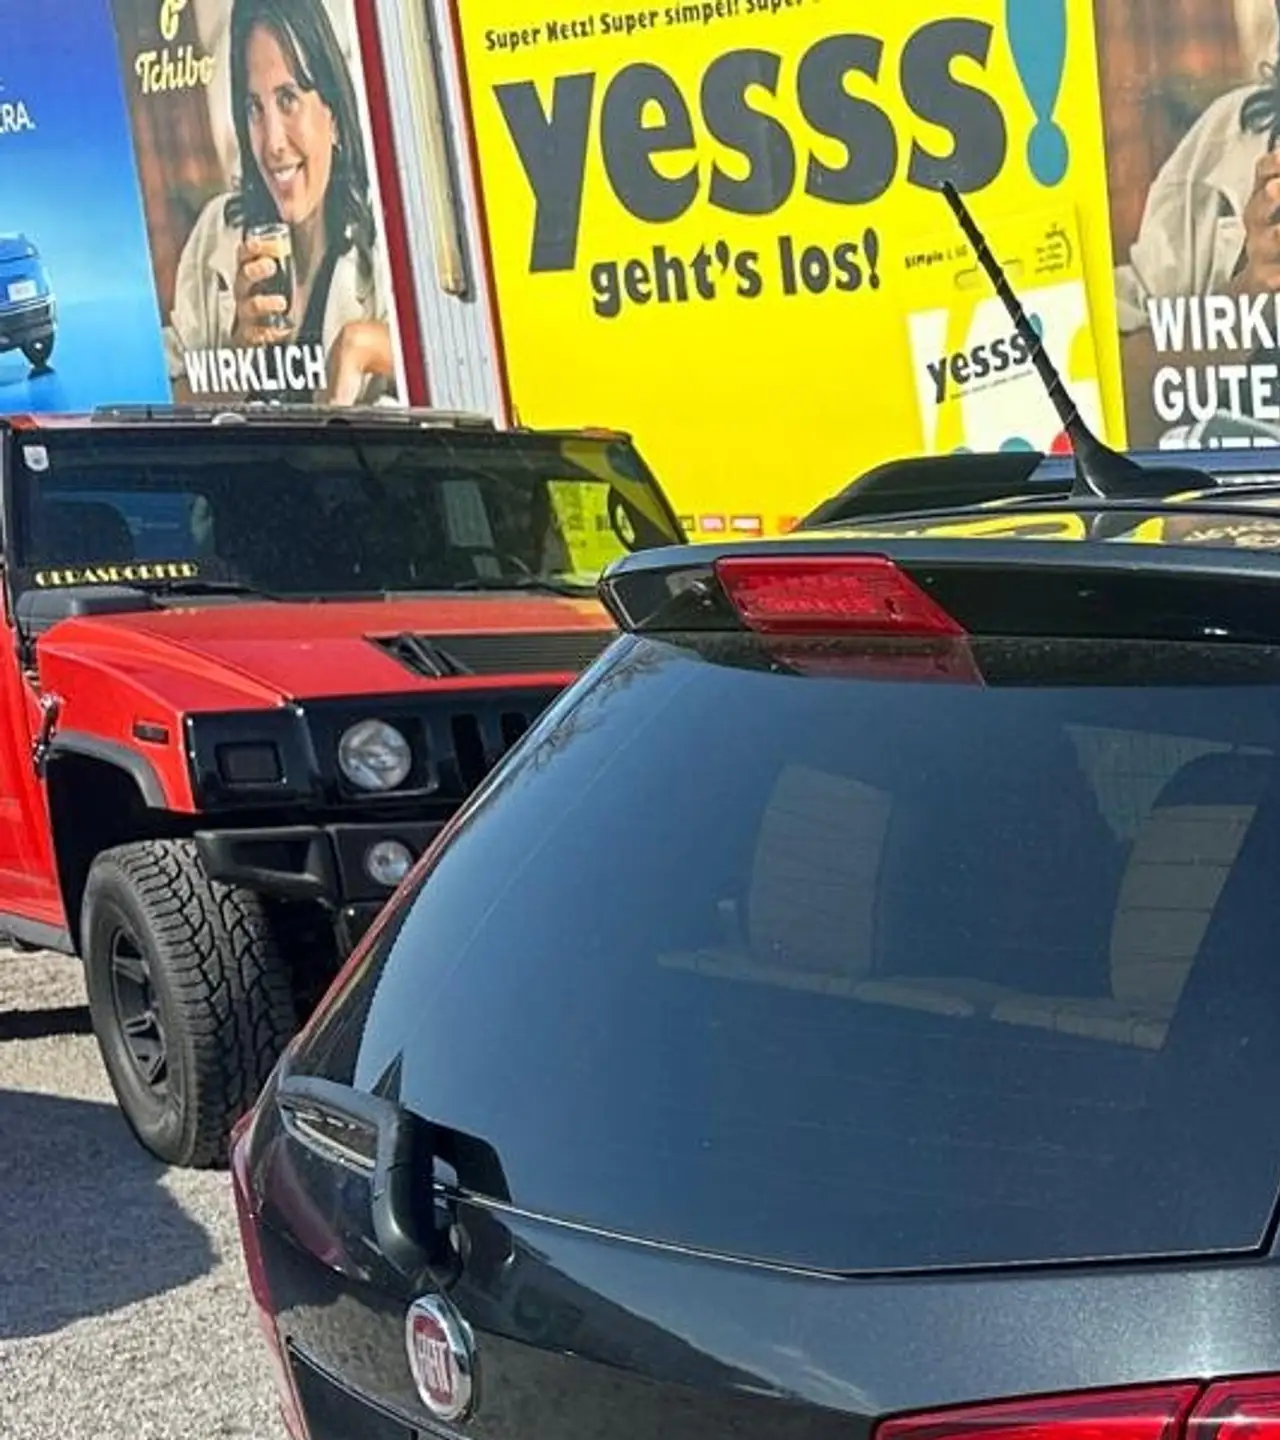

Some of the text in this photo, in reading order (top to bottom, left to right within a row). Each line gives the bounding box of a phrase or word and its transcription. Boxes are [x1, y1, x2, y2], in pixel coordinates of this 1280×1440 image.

[485, 29, 541, 52] Super
[547, 16, 594, 43] Netz!
[601, 9, 660, 36] Super
[135, 45, 216, 95] Tchibo
[0, 99, 36, 135] RA.
[590, 228, 881, 318] geht's los!
[184, 344, 328, 394] WIRKLICH
